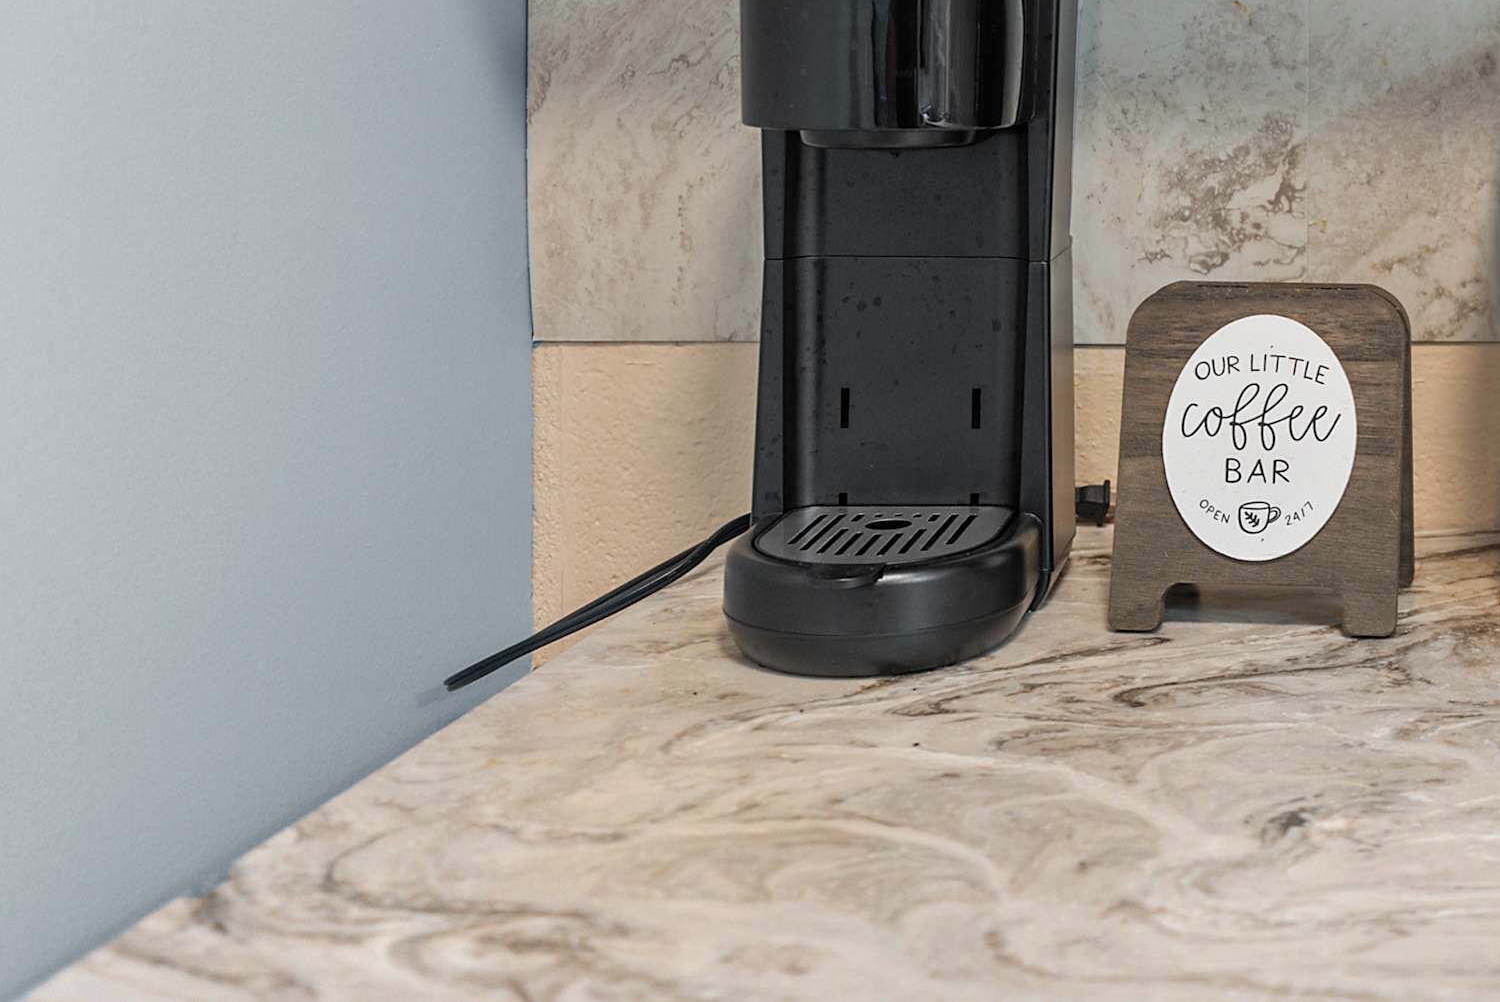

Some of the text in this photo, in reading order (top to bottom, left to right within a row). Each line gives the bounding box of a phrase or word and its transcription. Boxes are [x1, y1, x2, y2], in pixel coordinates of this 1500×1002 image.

[1194, 353, 1330, 385] OUR LITTLE
[1180, 382, 1342, 451] coffee
[1224, 457, 1290, 484] BAR
[1199, 498, 1231, 525] OPEN
[1284, 500, 1315, 527] 24/7
